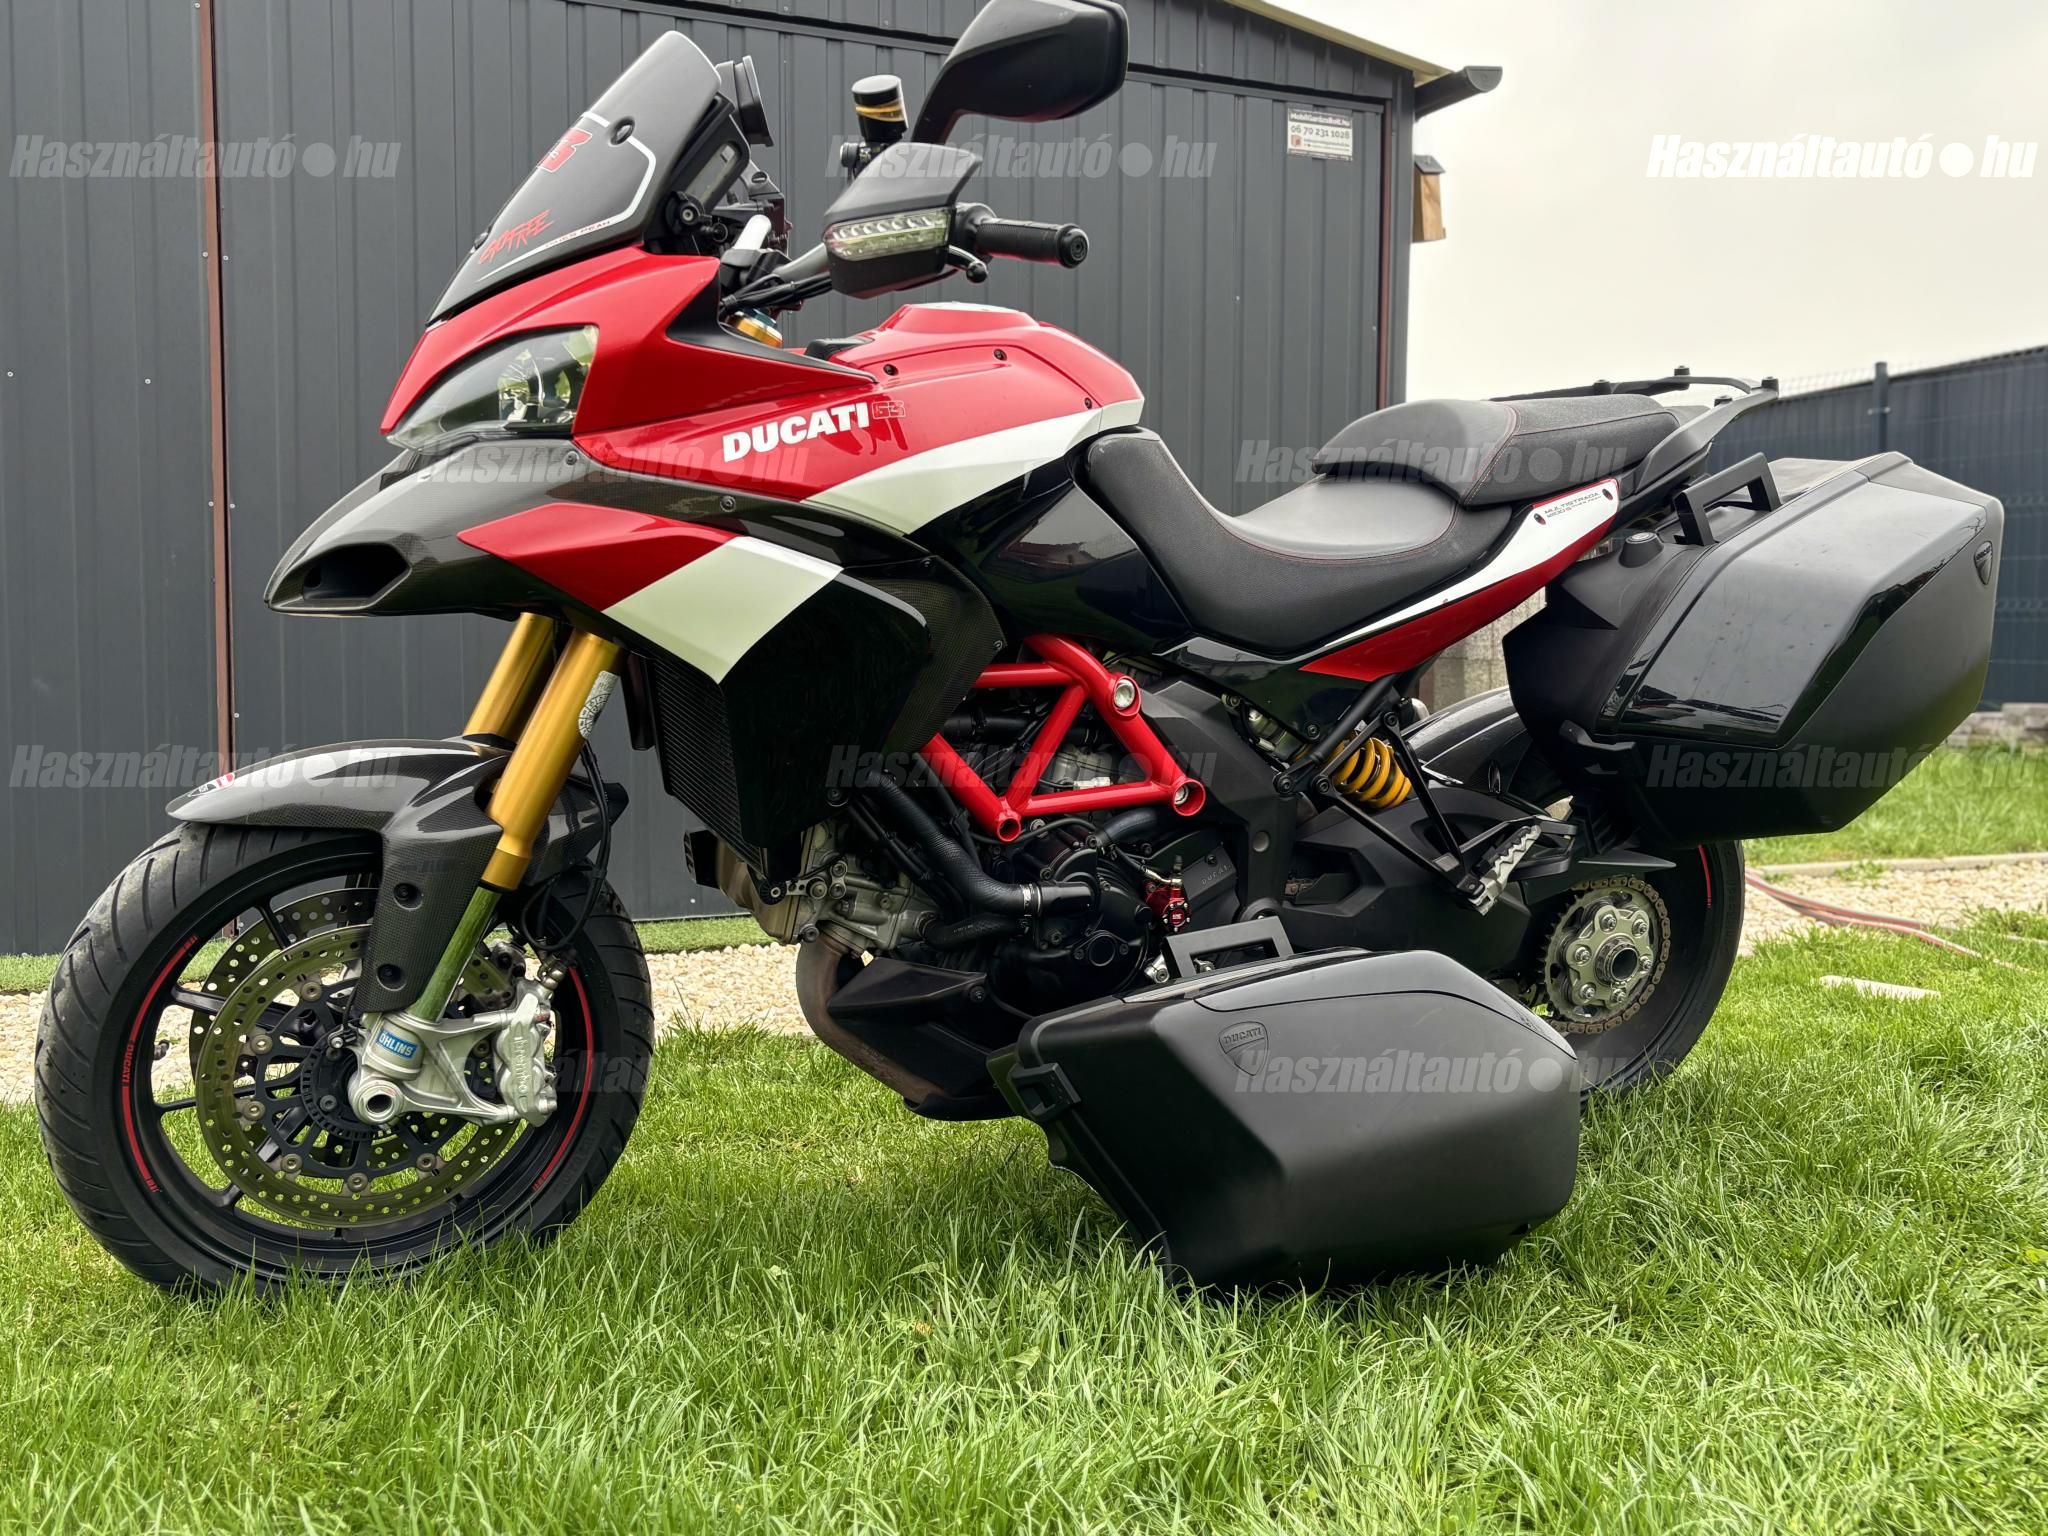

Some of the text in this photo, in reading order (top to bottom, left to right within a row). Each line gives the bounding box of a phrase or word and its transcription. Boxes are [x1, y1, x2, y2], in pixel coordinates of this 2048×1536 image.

[722, 402, 870, 463] DUCATI
[378, 1030, 414, 1059] ÖHLINS
[1223, 1027, 1262, 1045] DUCATI
[122, 1044, 135, 1083] DUCATI
